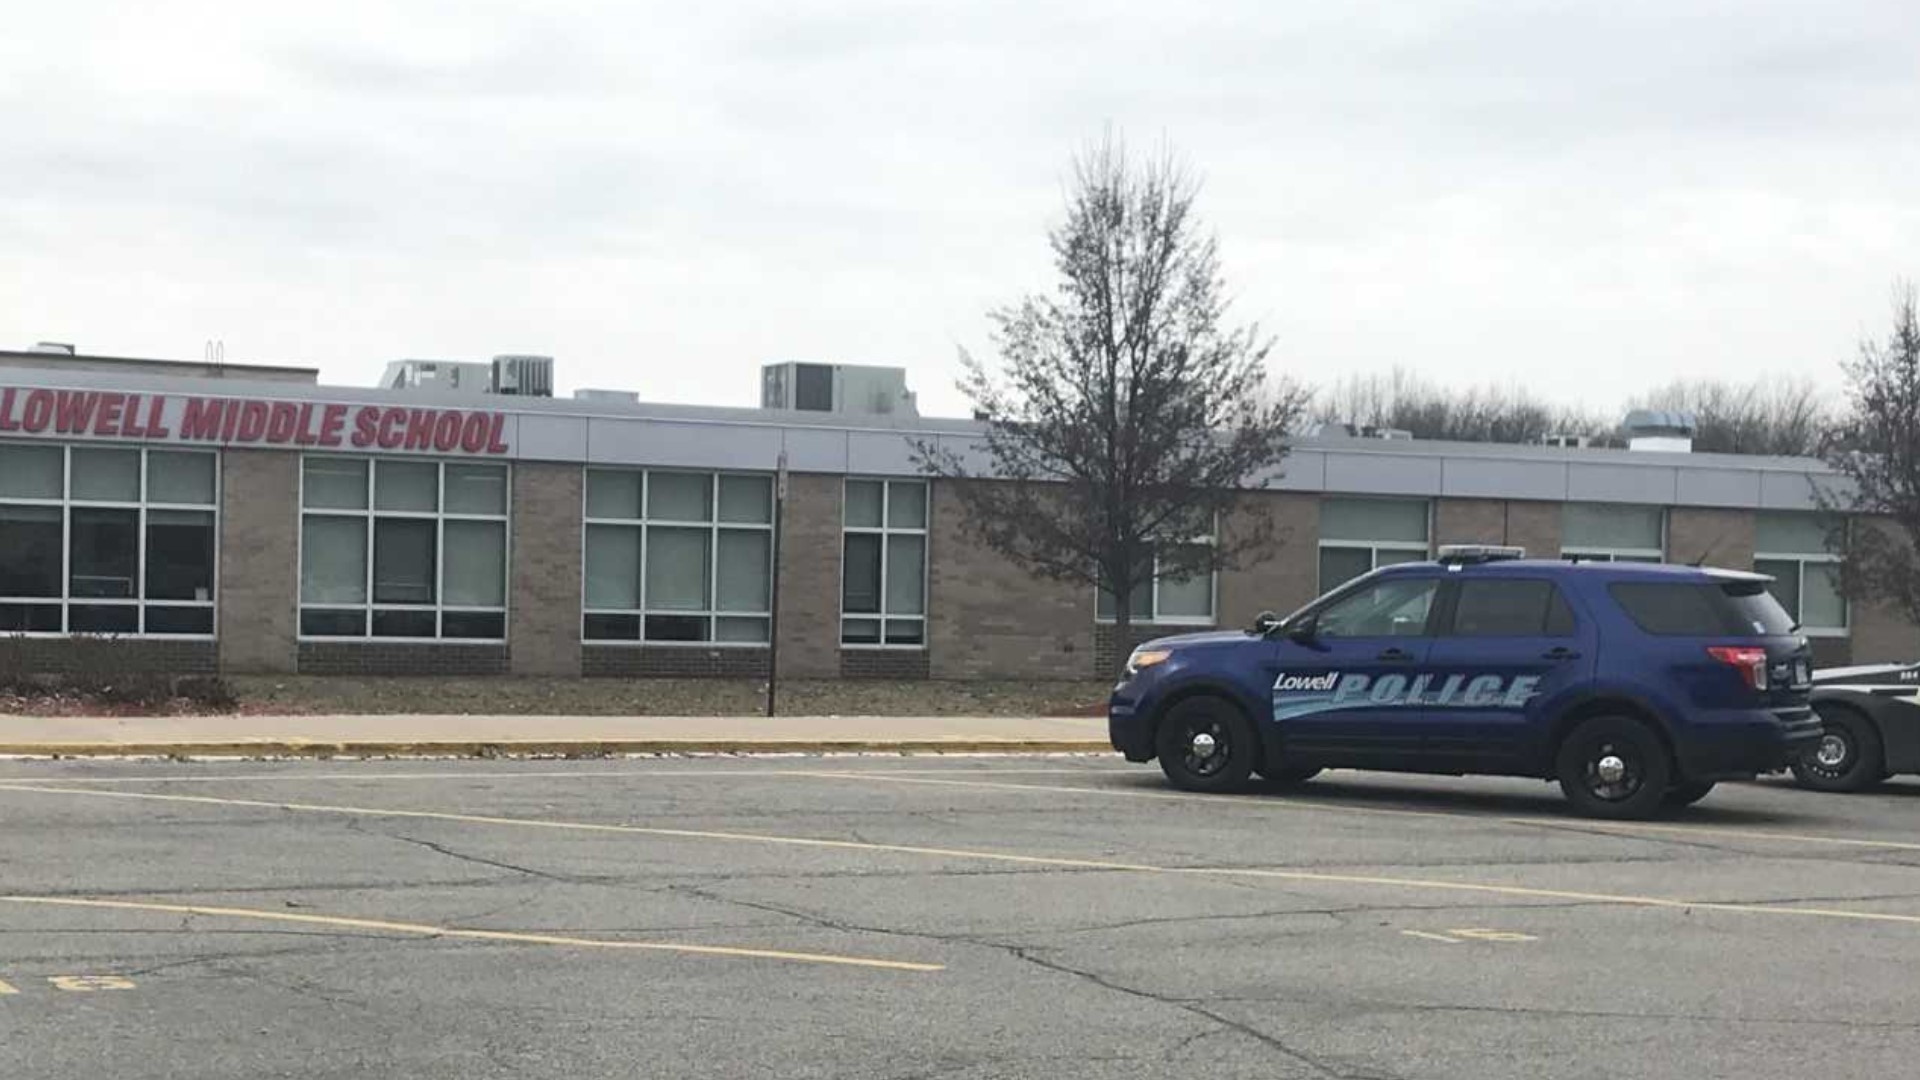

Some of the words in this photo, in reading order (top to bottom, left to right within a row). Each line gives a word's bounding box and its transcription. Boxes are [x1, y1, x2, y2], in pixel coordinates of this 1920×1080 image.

[0, 387, 169, 438] LOWELL
[180, 396, 347, 447] MIDDLE
[351, 405, 508, 454] SCHOOL
[1273, 671, 1339, 691] Lowell
[1333, 673, 1541, 706] POLICE
